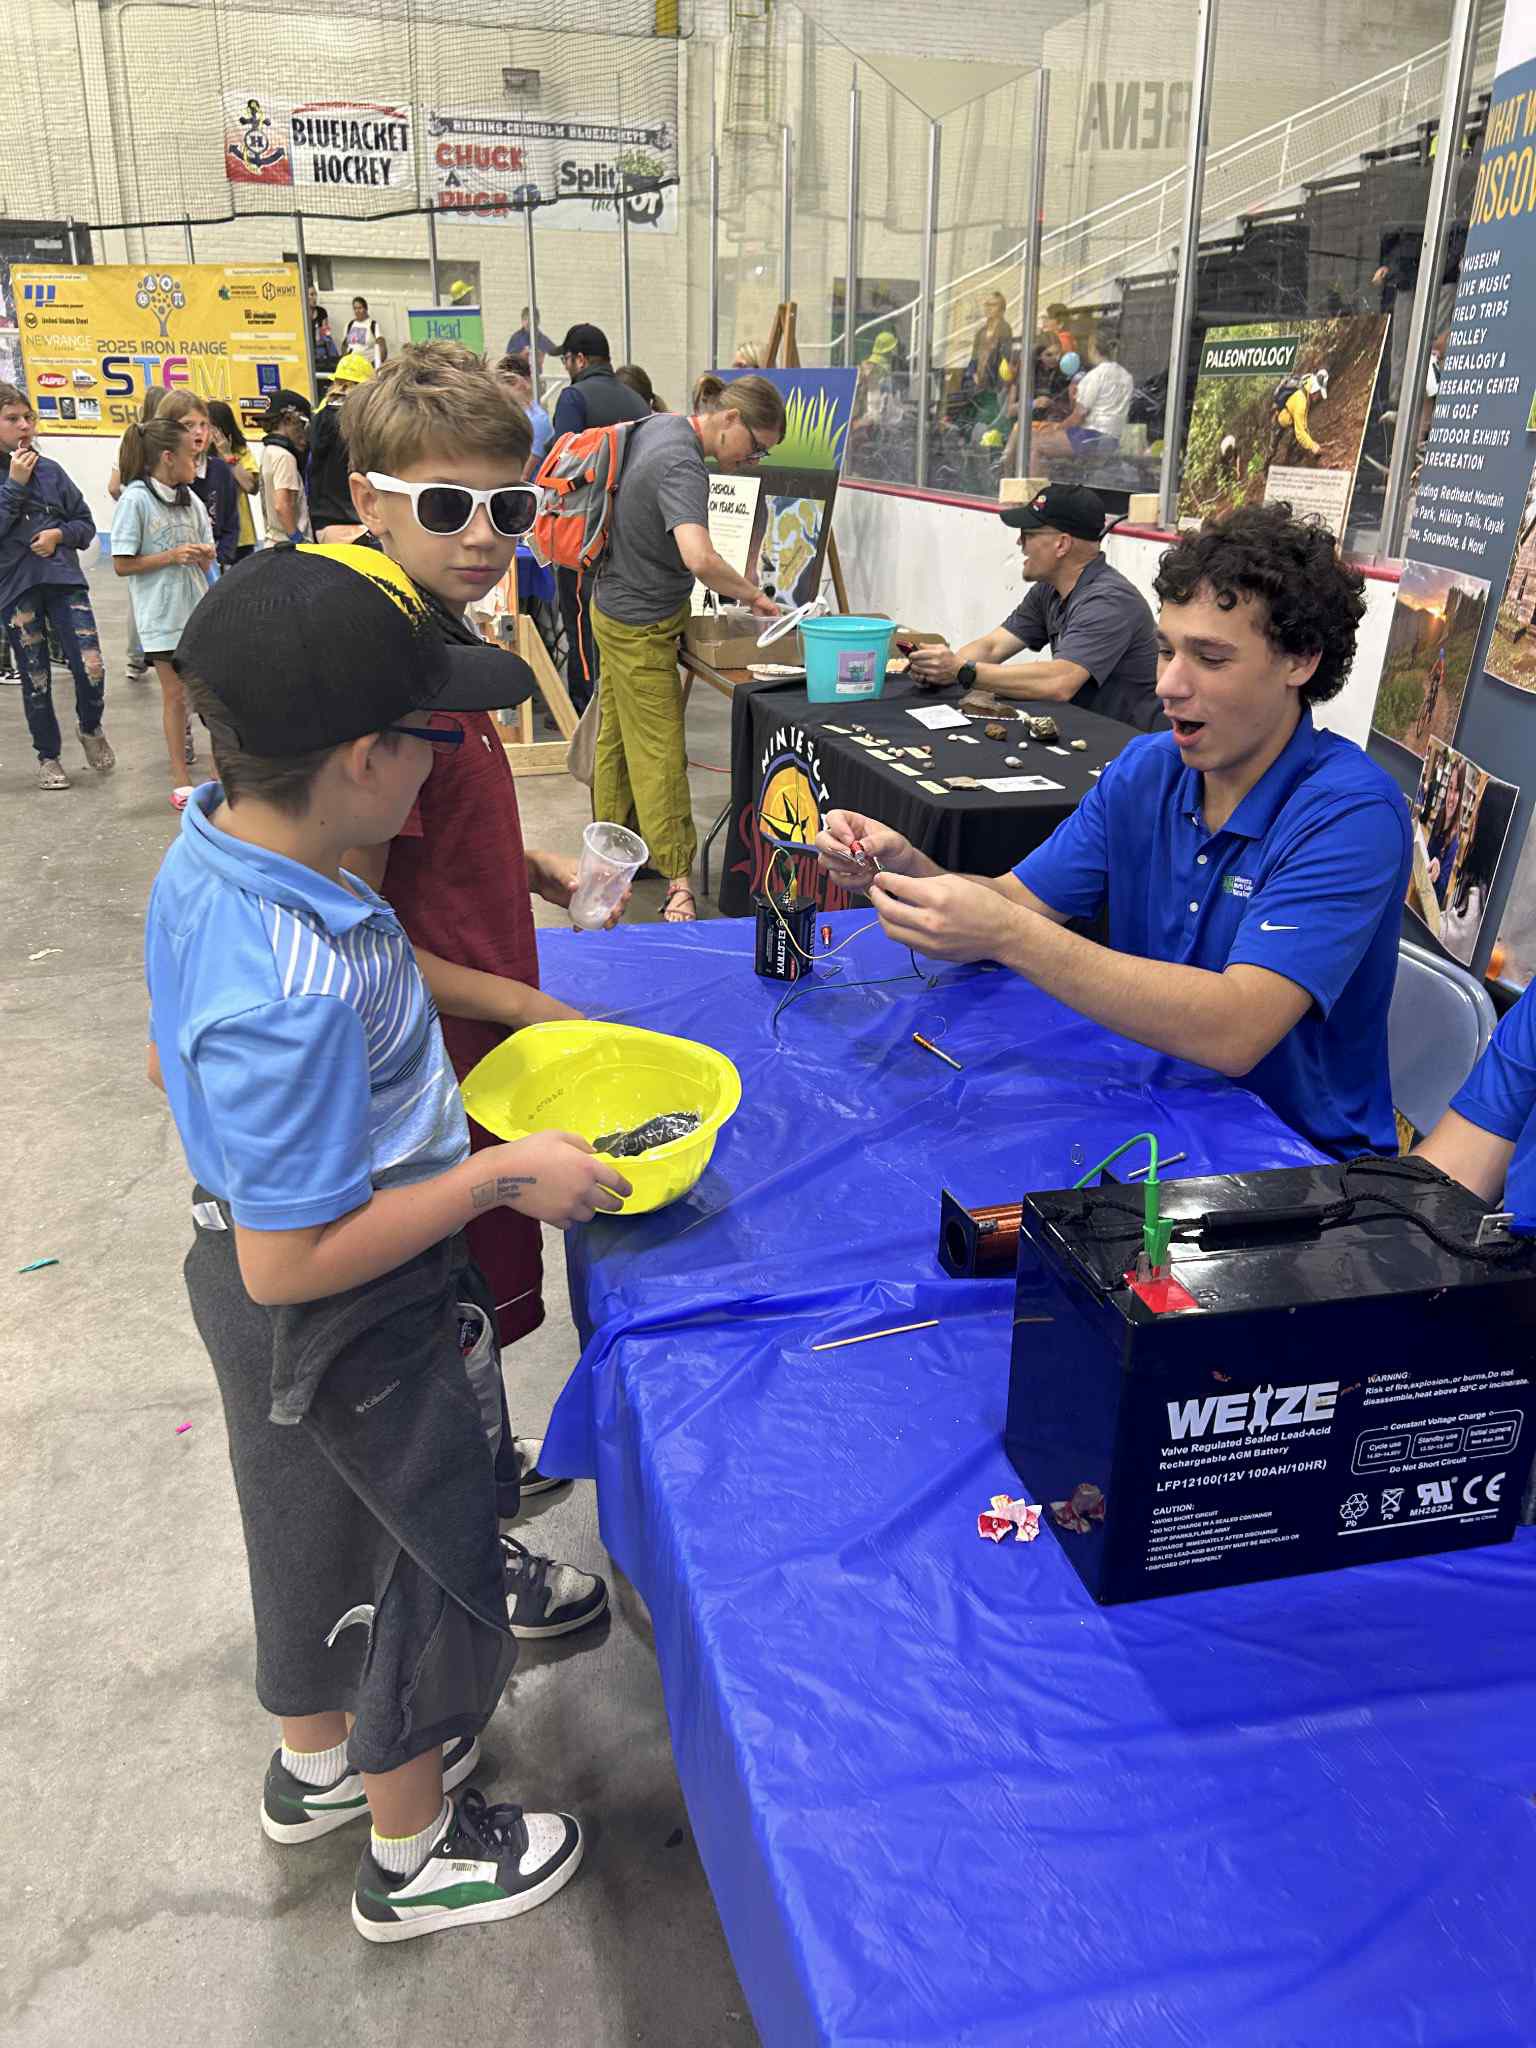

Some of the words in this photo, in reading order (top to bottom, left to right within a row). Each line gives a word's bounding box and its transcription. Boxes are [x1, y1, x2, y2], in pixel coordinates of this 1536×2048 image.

[291, 118, 410, 152] BLUEJACKET
[435, 142, 526, 172] CHUCK
[313, 154, 392, 185] HOCKEY
[560, 160, 616, 191] Split
[1457, 280, 1476, 297] LIVE
[1478, 274, 1511, 294] MUSIC
[1453, 304, 1476, 321] FIELD
[1480, 300, 1510, 319] TRIPS
[427, 318, 462, 338] Head
[1449, 328, 1487, 347] TROLLEY
[97, 340, 138, 353] 2025
[141, 341, 175, 354] IRON
[180, 341, 228, 354] RANGE
[1205, 346, 1295, 369] PALEONTOLOGY
[1443, 352, 1498, 371] GENEALOGY
[102, 356, 233, 399] STEM
[1440, 379, 1483, 395] RESEARCH
[1486, 376, 1520, 394] CENTER
[1433, 403, 1450, 418] MINI
[1452, 404, 1479, 419] GOLF
[1428, 428, 1470, 445] OUTDOOR
[1472, 429, 1511, 446] EXHIBITS
[1427, 452, 1485, 470] RECREATION
[1440, 485, 1473, 503] Redhead
[1474, 489, 1504, 507] Mountain
[1420, 505, 1436, 522] Park,
[1439, 509, 1464, 527] Hiking
[1483, 516, 1505, 535] Kayak
[1422, 529, 1459, 551] Snowshoe,
[1468, 539, 1487, 555] More!
[1500, 1368, 1515, 1377] not
[1433, 1388, 1457, 1397] above
[1167, 1381, 1340, 1440] WEIZE
[1390, 1419, 1427, 1431] Constant
[1428, 1415, 1457, 1426] Voltage
[1458, 1411, 1487, 1422] Charge
[1161, 1447, 1189, 1457] Valve
[1190, 1438, 1242, 1454] Regulated
[1244, 1432, 1279, 1445] Sealed
[1281, 1426, 1332, 1441] Lead-Acid
[1159, 1454, 1227, 1470] Rechargeable
[1228, 1450, 1252, 1461] AGM
[1253, 1446, 1289, 1458] Battery
[1389, 1466, 1400, 1474] Do
[1402, 1463, 1417, 1472] Not
[1418, 1460, 1439, 1470] Short
[1441, 1456, 1467, 1466] Circuit
[1157, 1471, 1245, 1492] LFP12100(12V
[1249, 1459, 1327, 1479] 100AH/10HR)
[1153, 1503, 1195, 1516] CAUTION:
[1345, 1520, 1357, 1528] Pb
